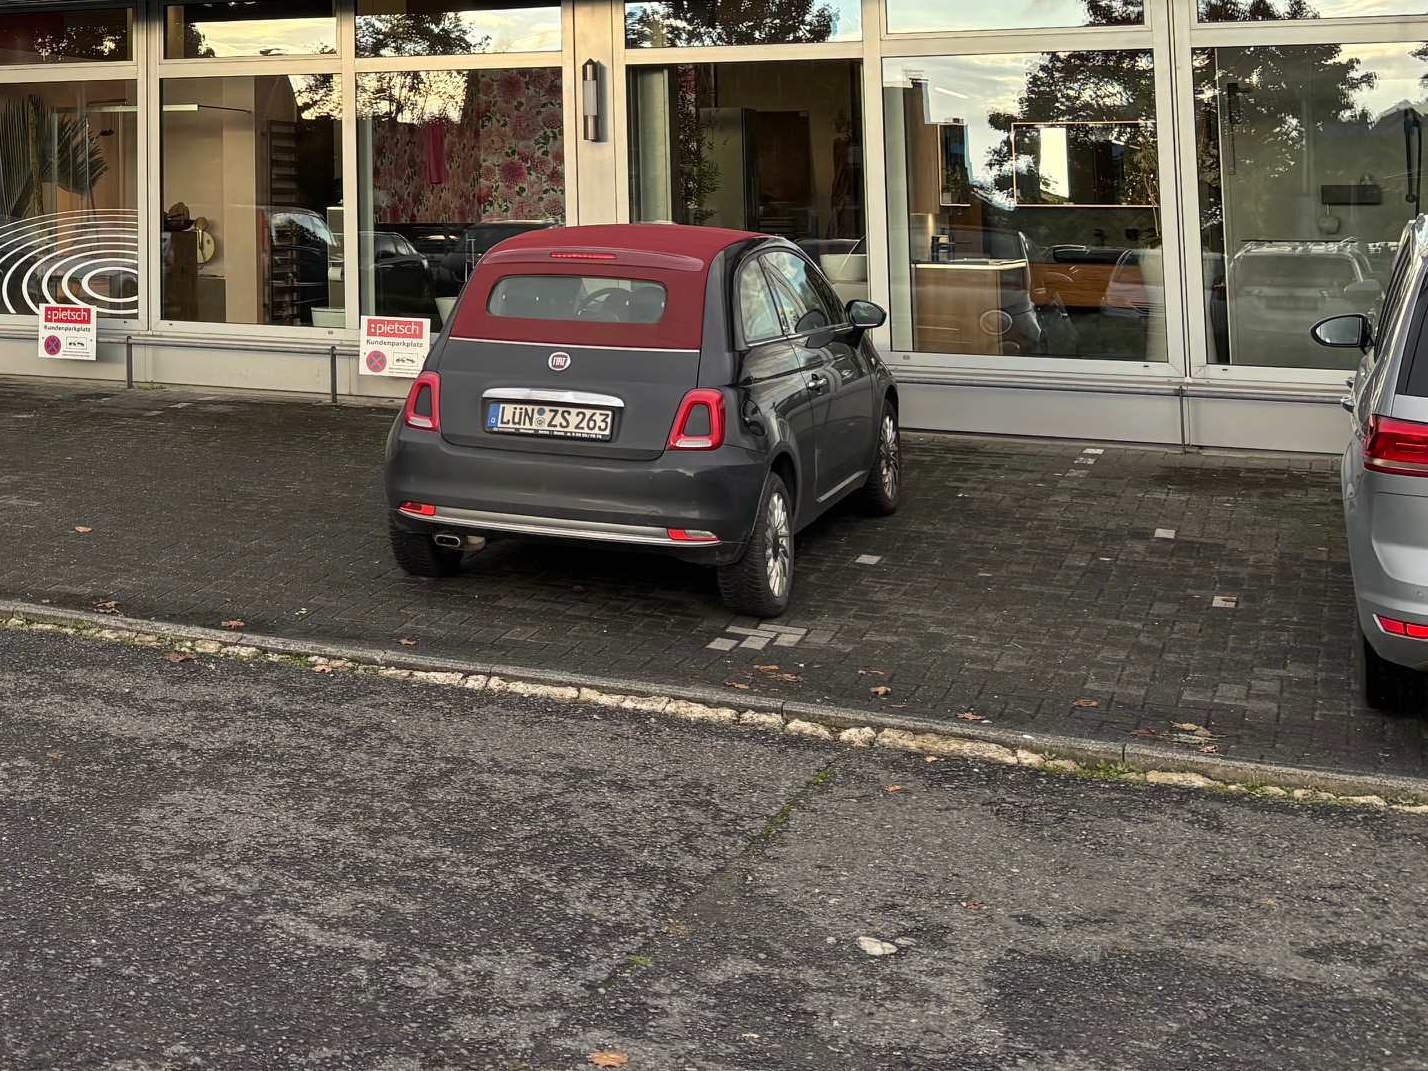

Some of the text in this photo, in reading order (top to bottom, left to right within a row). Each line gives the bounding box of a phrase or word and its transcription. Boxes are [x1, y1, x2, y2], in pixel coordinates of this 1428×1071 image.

[366, 338, 423, 348] Kundenparkplatz
[547, 409, 572, 429] ZS
[574, 411, 610, 432] 263
